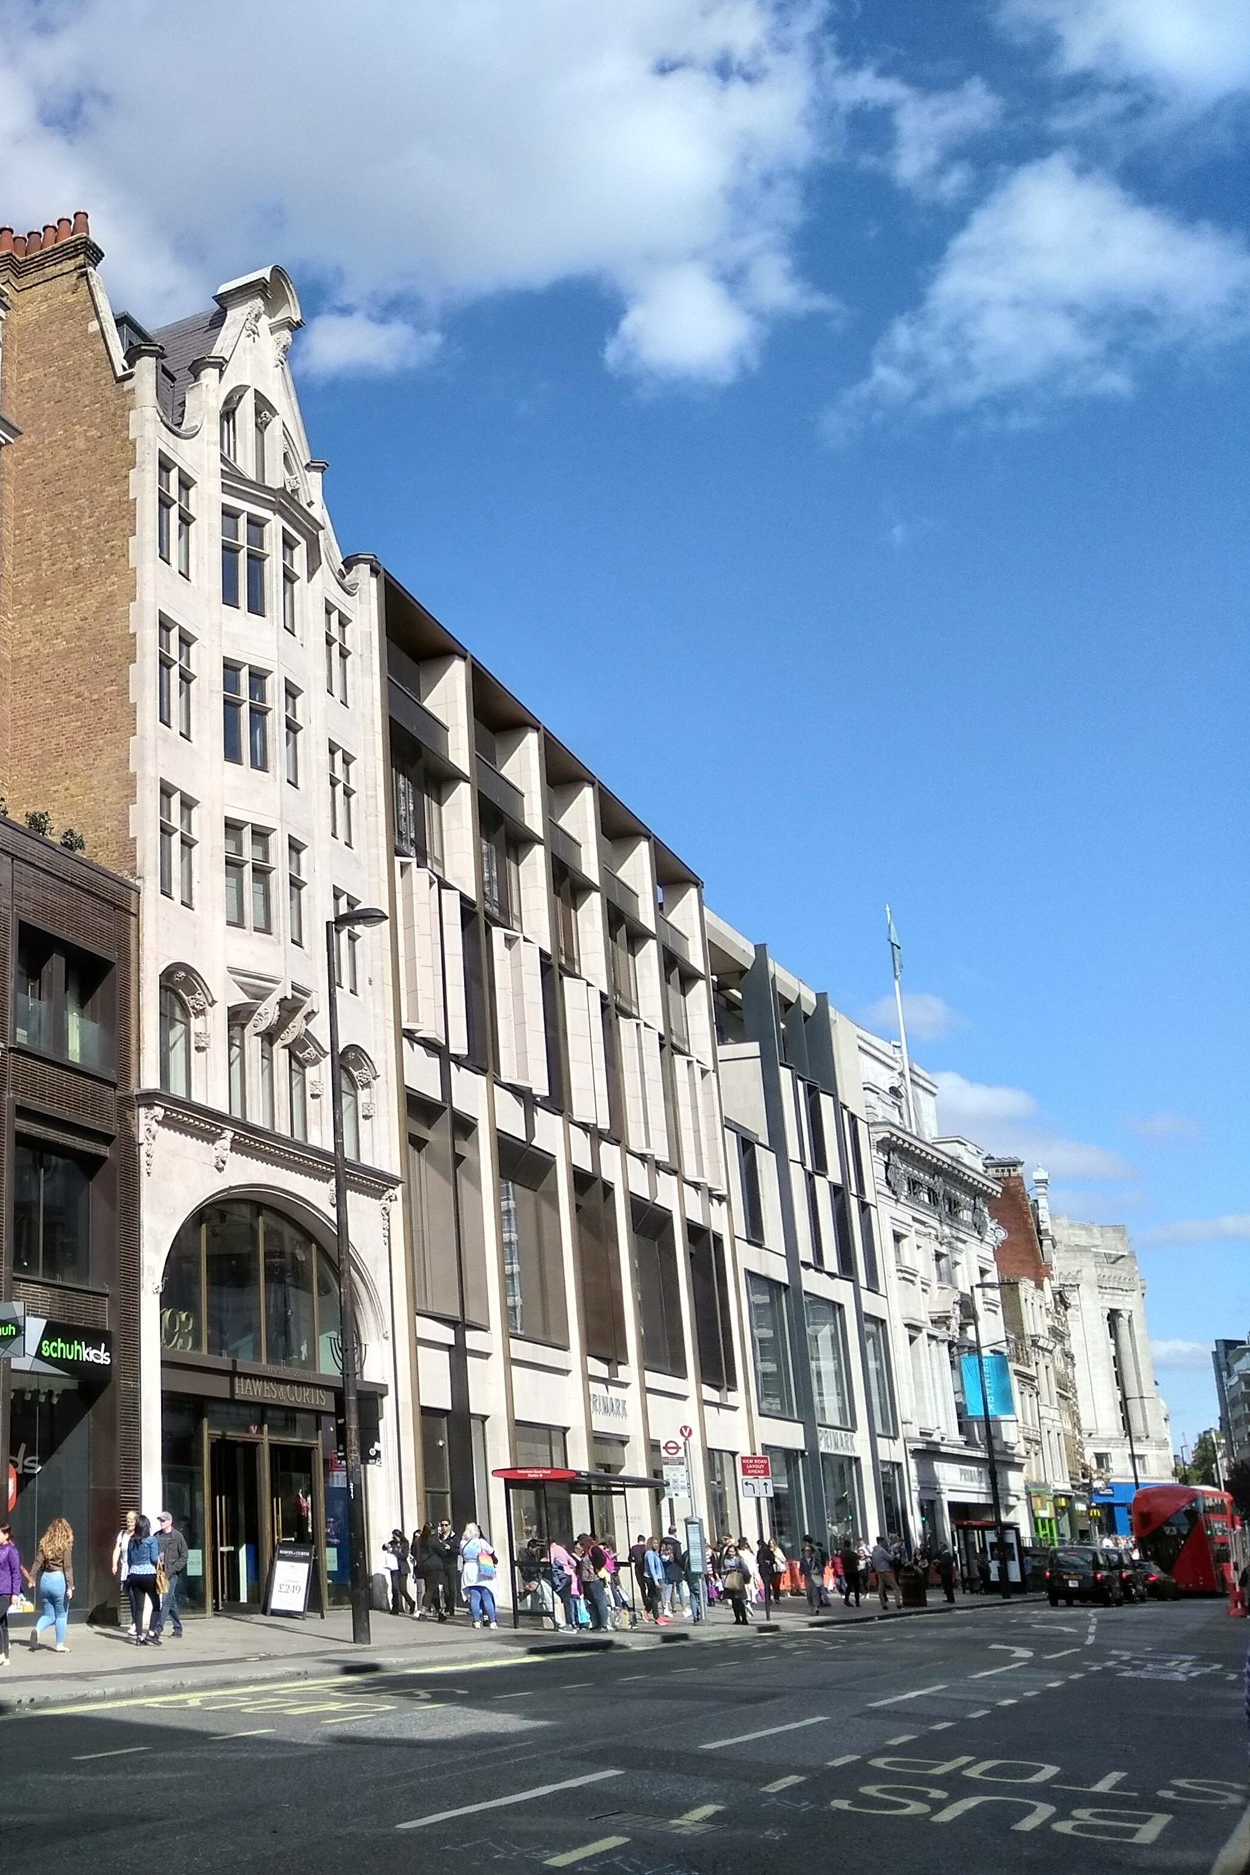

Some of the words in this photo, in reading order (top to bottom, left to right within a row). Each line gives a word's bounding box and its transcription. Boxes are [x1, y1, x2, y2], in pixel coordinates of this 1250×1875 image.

[235, 1376, 277, 1399] HAWES
[278, 1385, 285, 1400] &
[286, 1384, 326, 1406] CURTIS
[681, 1427, 690, 1437] V
[818, 1429, 856, 1453] PRIMARK
[278, 1583, 302, 1594] £249
[867, 1755, 1248, 1804] STOP
[830, 1784, 1174, 1844] BUS
